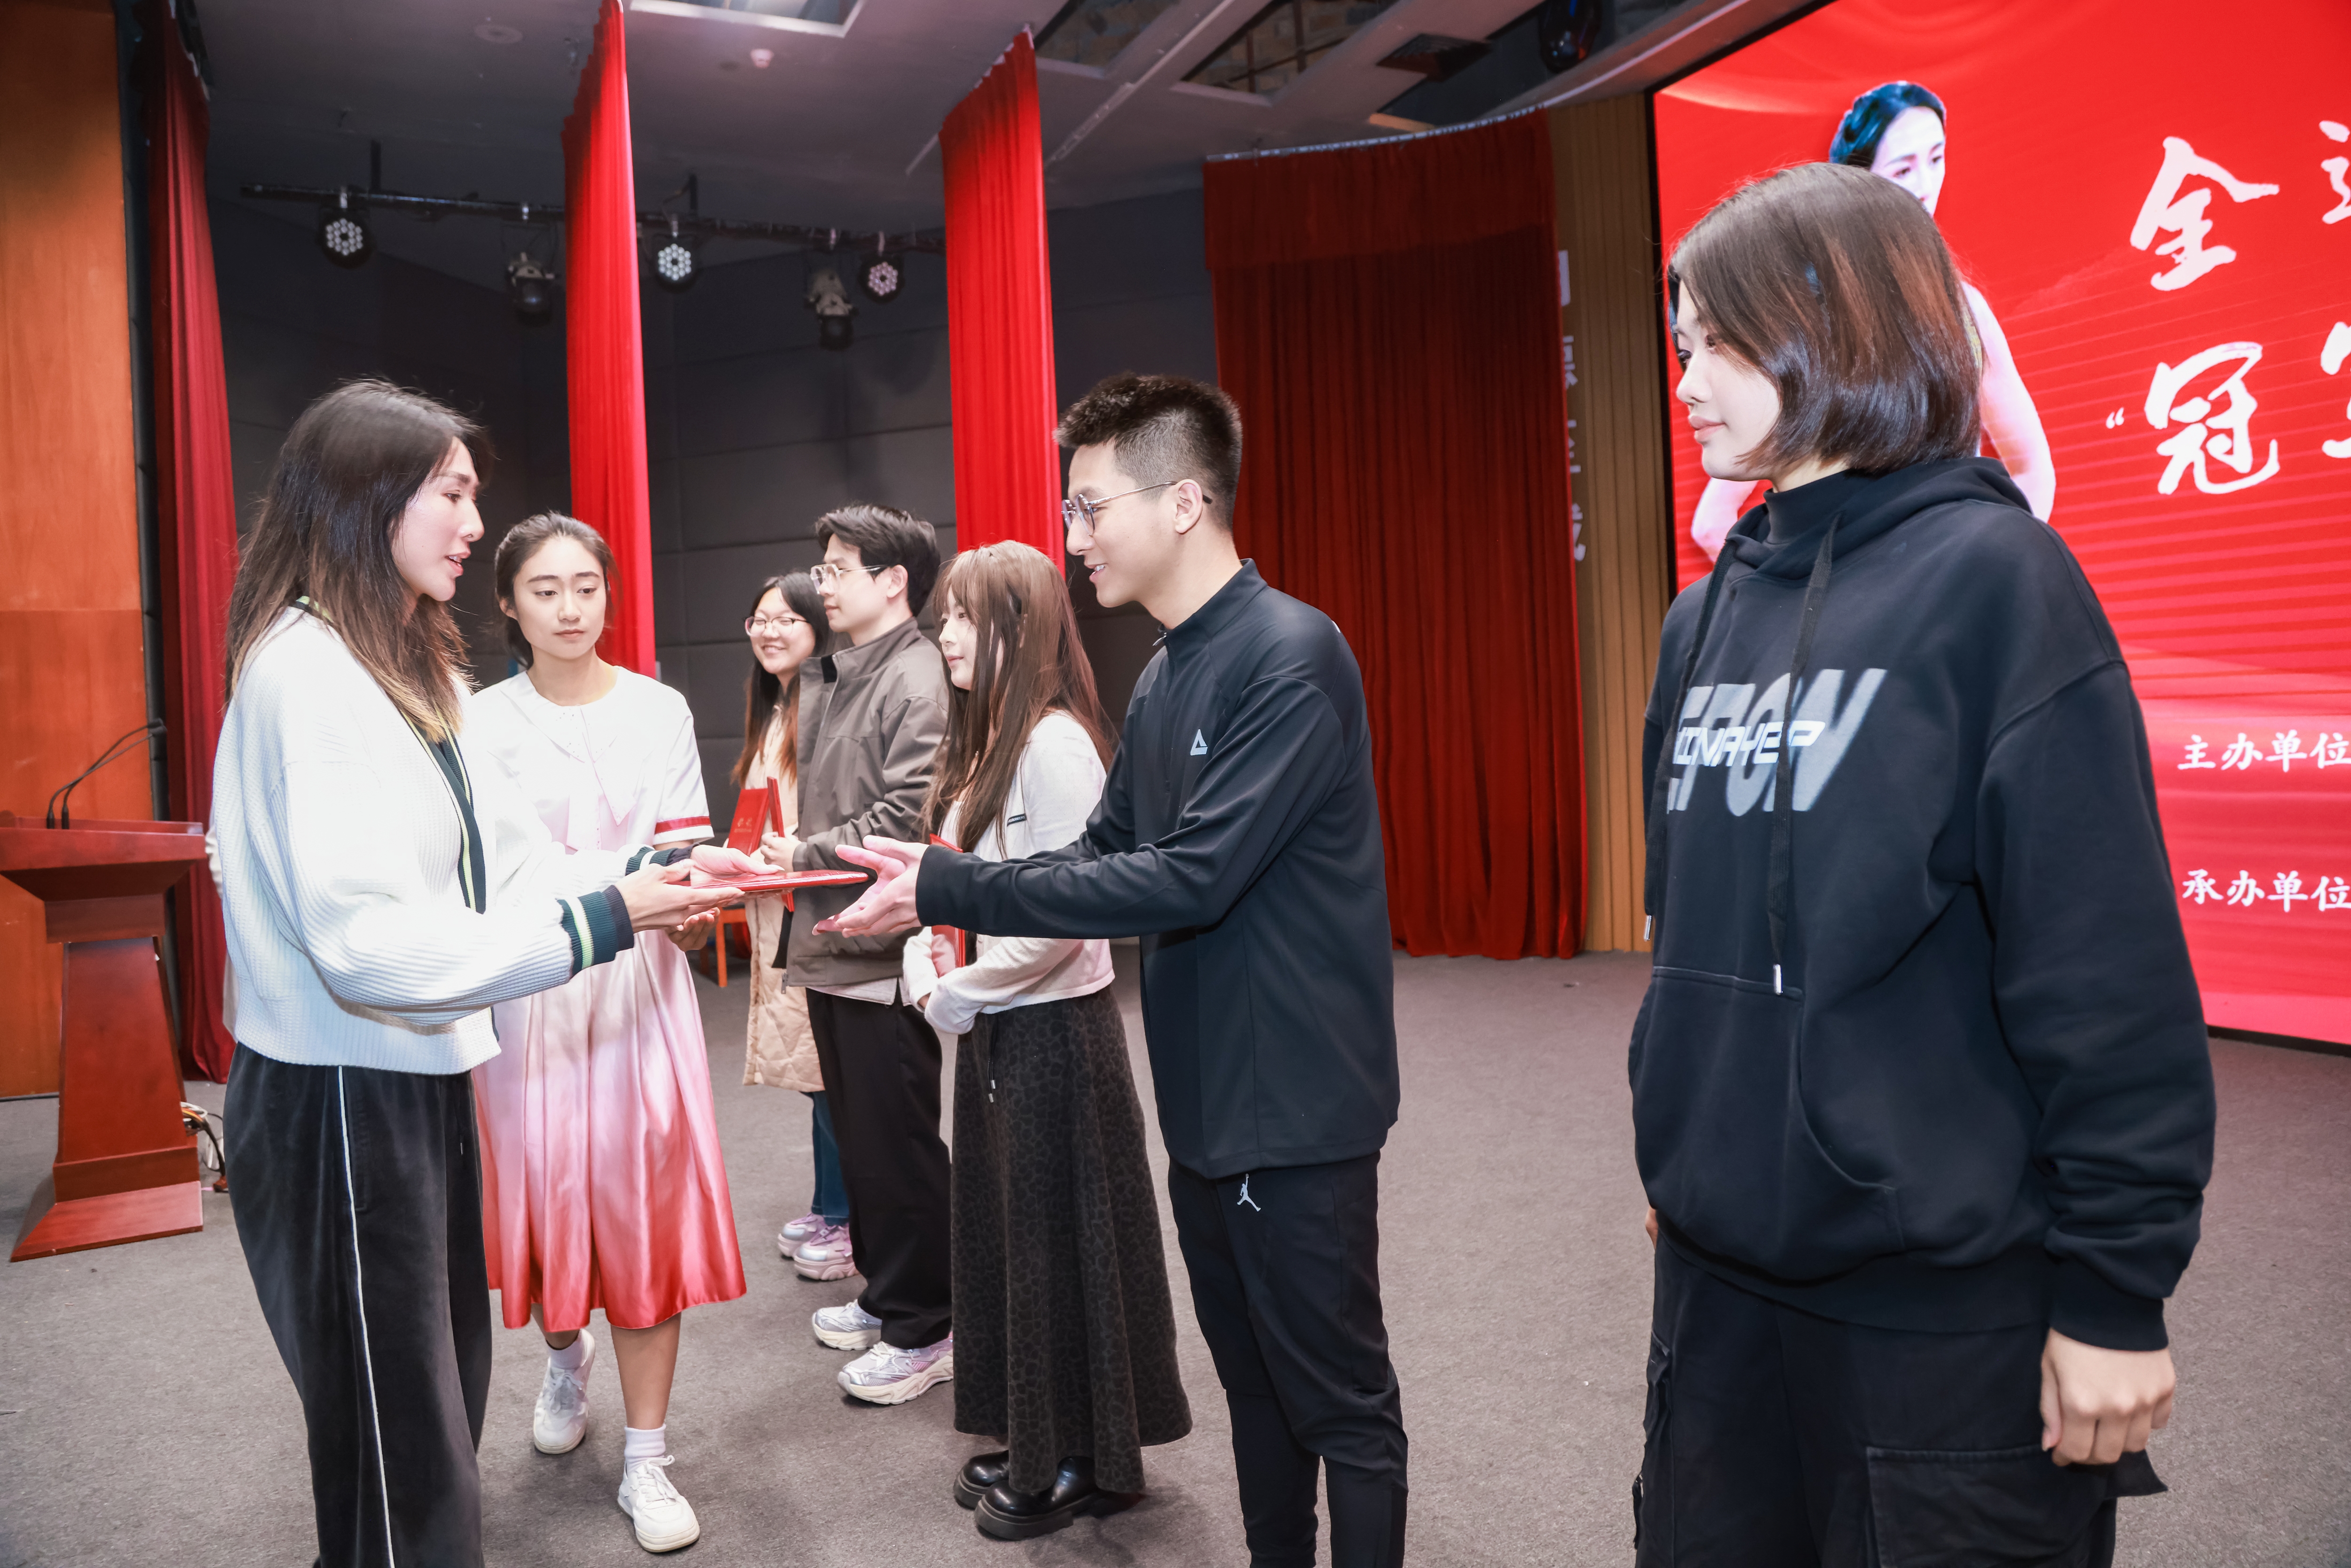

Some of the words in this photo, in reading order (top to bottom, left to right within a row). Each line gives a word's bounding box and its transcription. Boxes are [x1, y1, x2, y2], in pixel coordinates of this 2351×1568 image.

[2177, 729, 2351, 772] 主办单位
[2182, 869, 2351, 912] 承办单位
